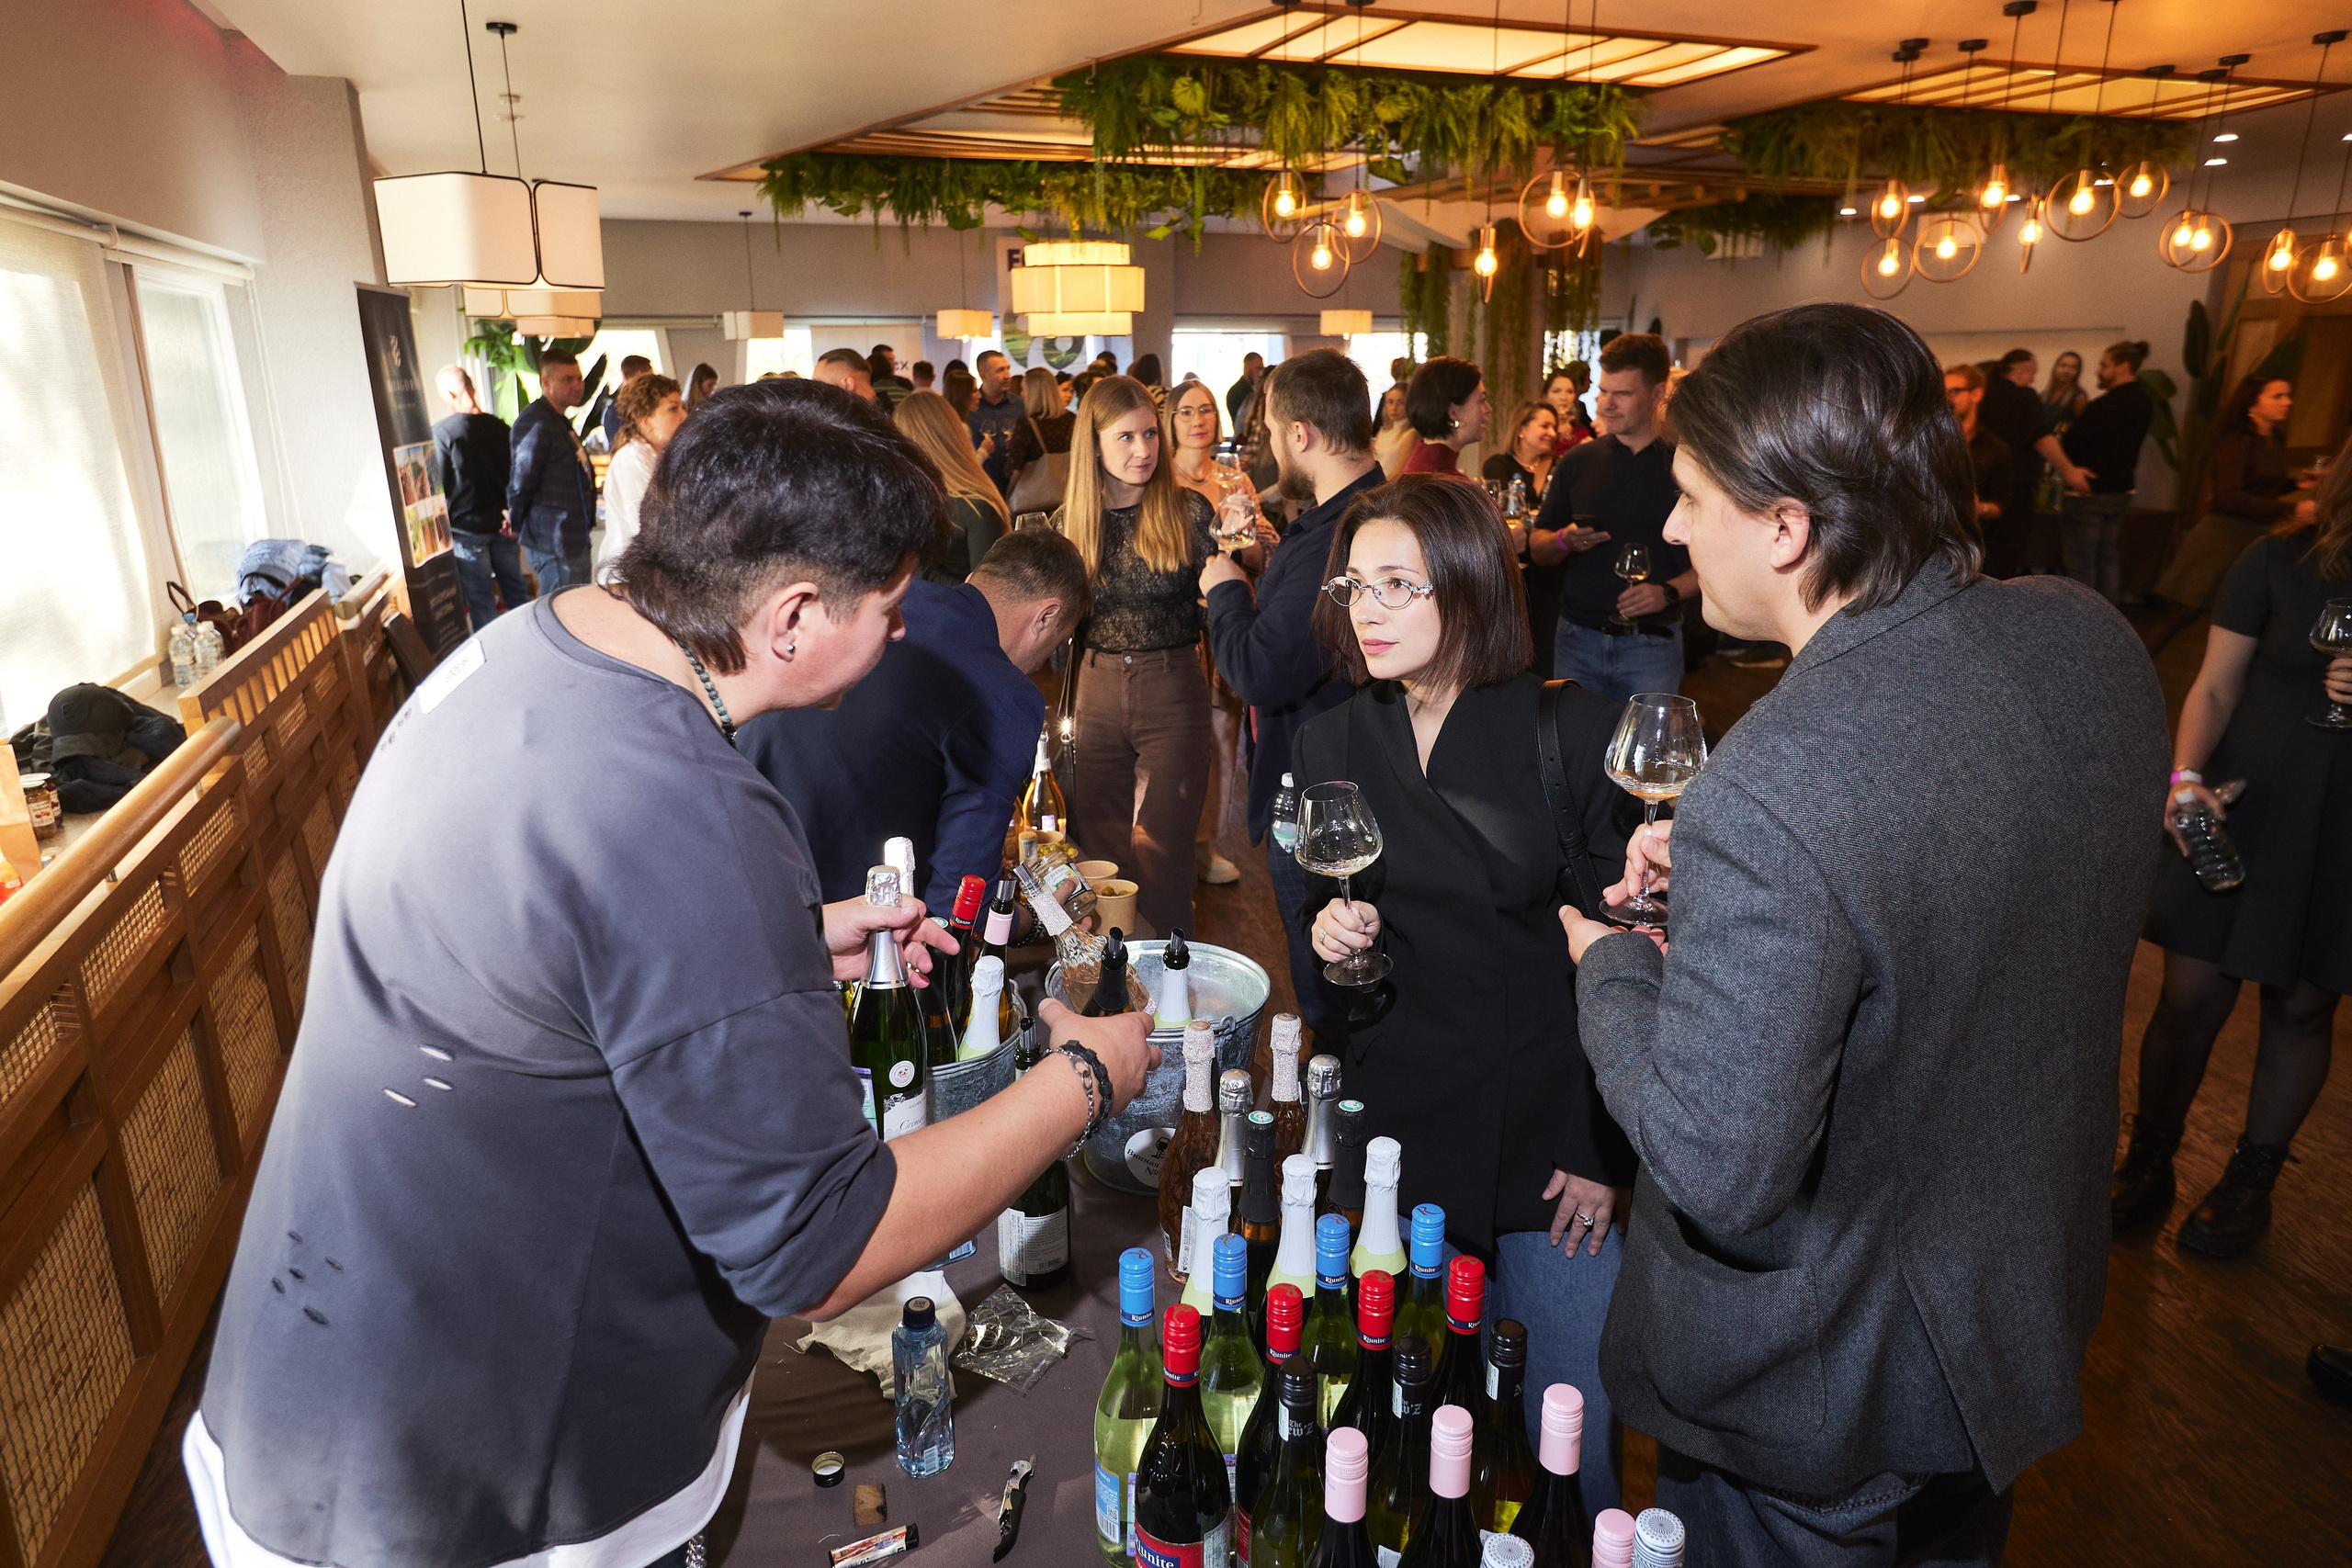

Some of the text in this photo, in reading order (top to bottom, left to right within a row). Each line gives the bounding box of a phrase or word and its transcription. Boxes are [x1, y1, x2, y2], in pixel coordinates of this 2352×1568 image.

[1126, 1148, 1159, 1168] Винная
[1415, 1264, 1436, 1273] Riunite
[1325, 1275, 1346, 1284] Riunite
[1225, 1294, 1245, 1305] Riunite
[1131, 1311, 1153, 1322] Riunite
[1363, 1334, 1386, 1344] Riunite
[1288, 1421, 1314, 1437] ew'Z
